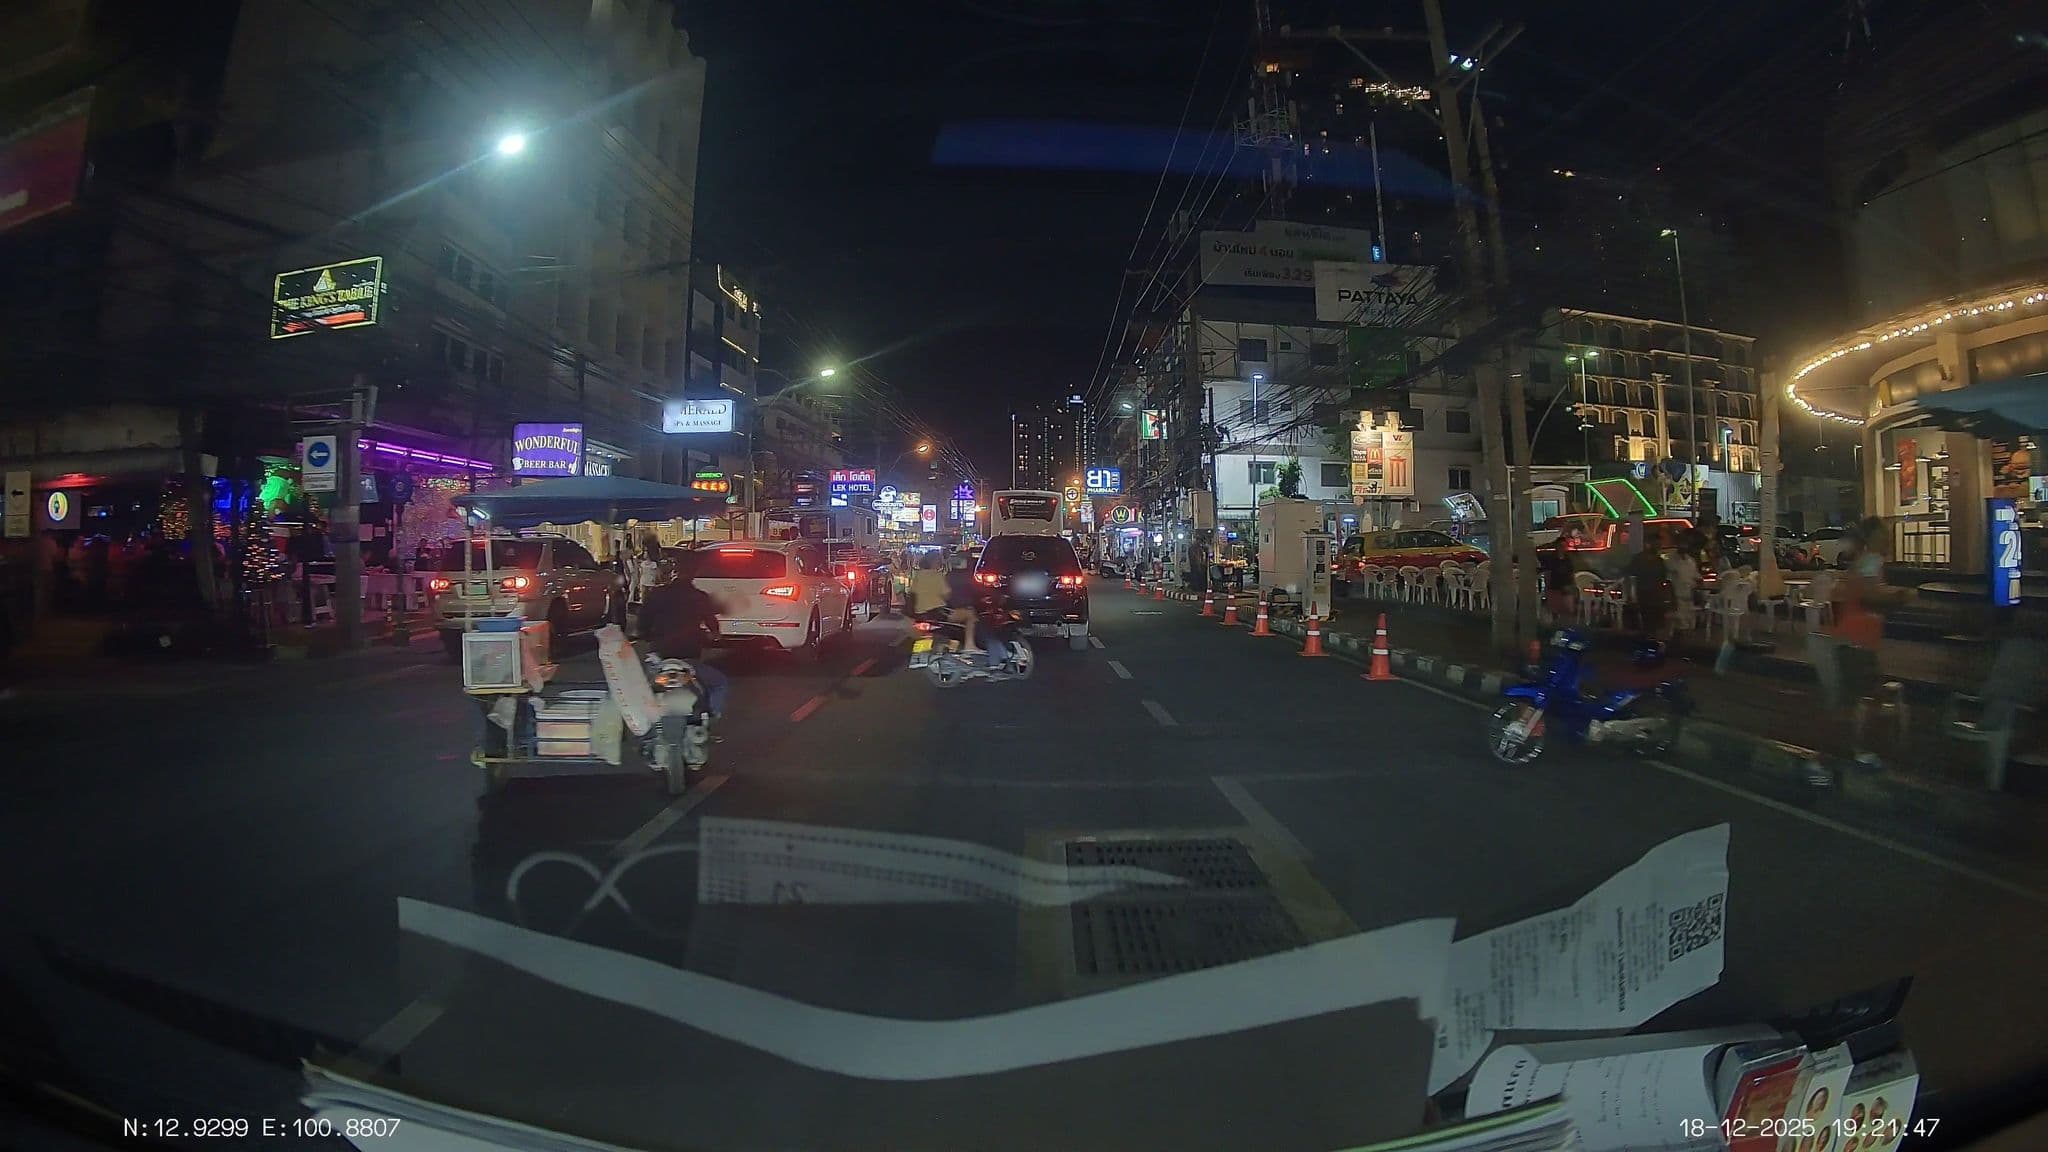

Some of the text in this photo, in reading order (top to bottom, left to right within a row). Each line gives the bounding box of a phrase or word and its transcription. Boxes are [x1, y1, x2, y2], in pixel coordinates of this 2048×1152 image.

[1337, 289, 1418, 306] PATTAYA
[515, 435, 582, 456] WONDERFUL
[524, 460, 567, 469] BEER BAR
[848, 483, 872, 492] HOTEL
